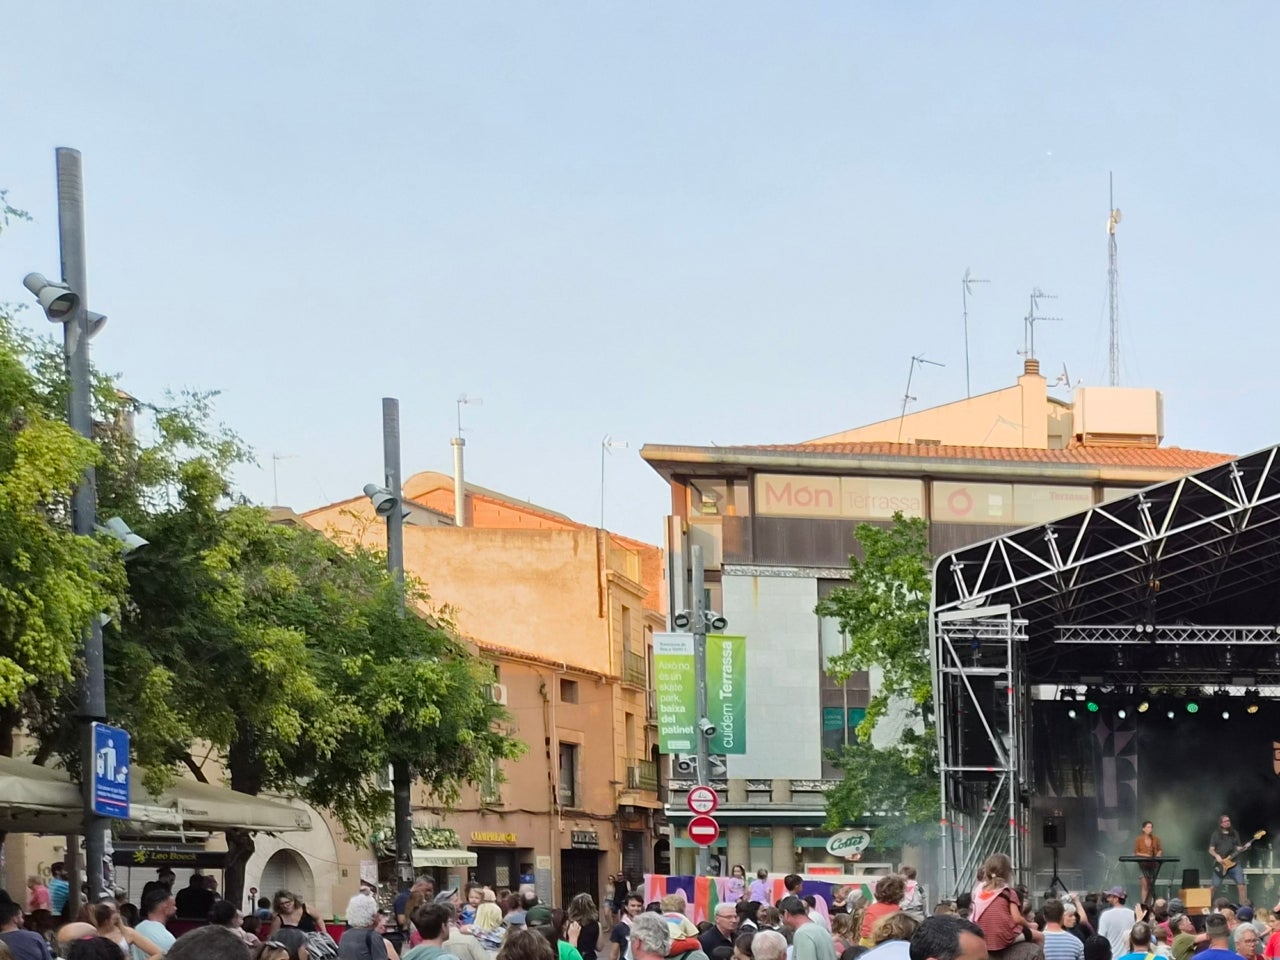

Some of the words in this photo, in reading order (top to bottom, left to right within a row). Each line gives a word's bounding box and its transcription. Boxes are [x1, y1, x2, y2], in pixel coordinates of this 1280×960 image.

[848, 491, 920, 511] Terrassa
[719, 641, 733, 700] Terrassa
[660, 704, 686, 713] baixa
[661, 714, 676, 723] del
[721, 704, 734, 748] cuidem
[661, 725, 694, 736] patinet
